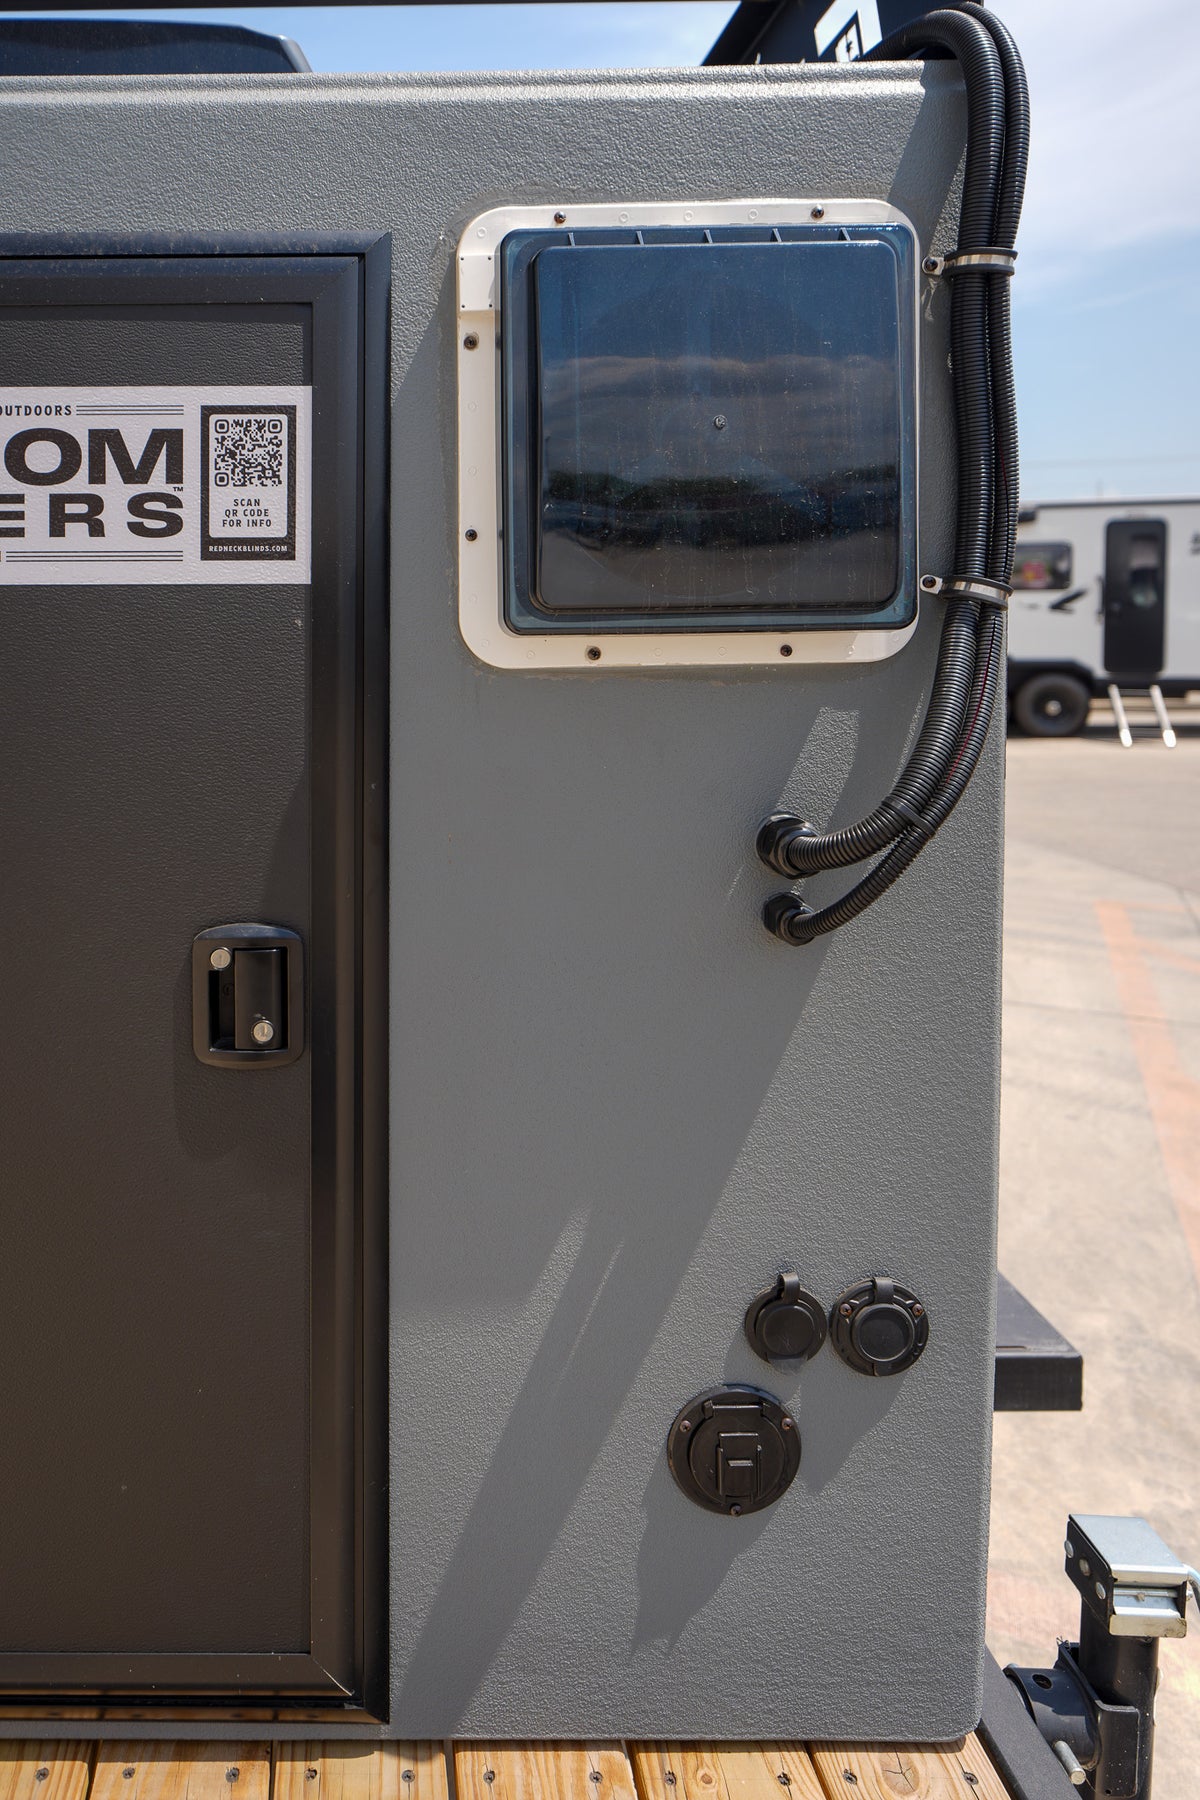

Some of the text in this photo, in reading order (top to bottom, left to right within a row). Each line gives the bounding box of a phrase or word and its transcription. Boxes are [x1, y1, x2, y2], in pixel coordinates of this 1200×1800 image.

[3, 427, 184, 487] OM
[233, 498, 261, 507] SCAN
[224, 508, 270, 519] QR CODE
[222, 519, 272, 528] FOR INFO
